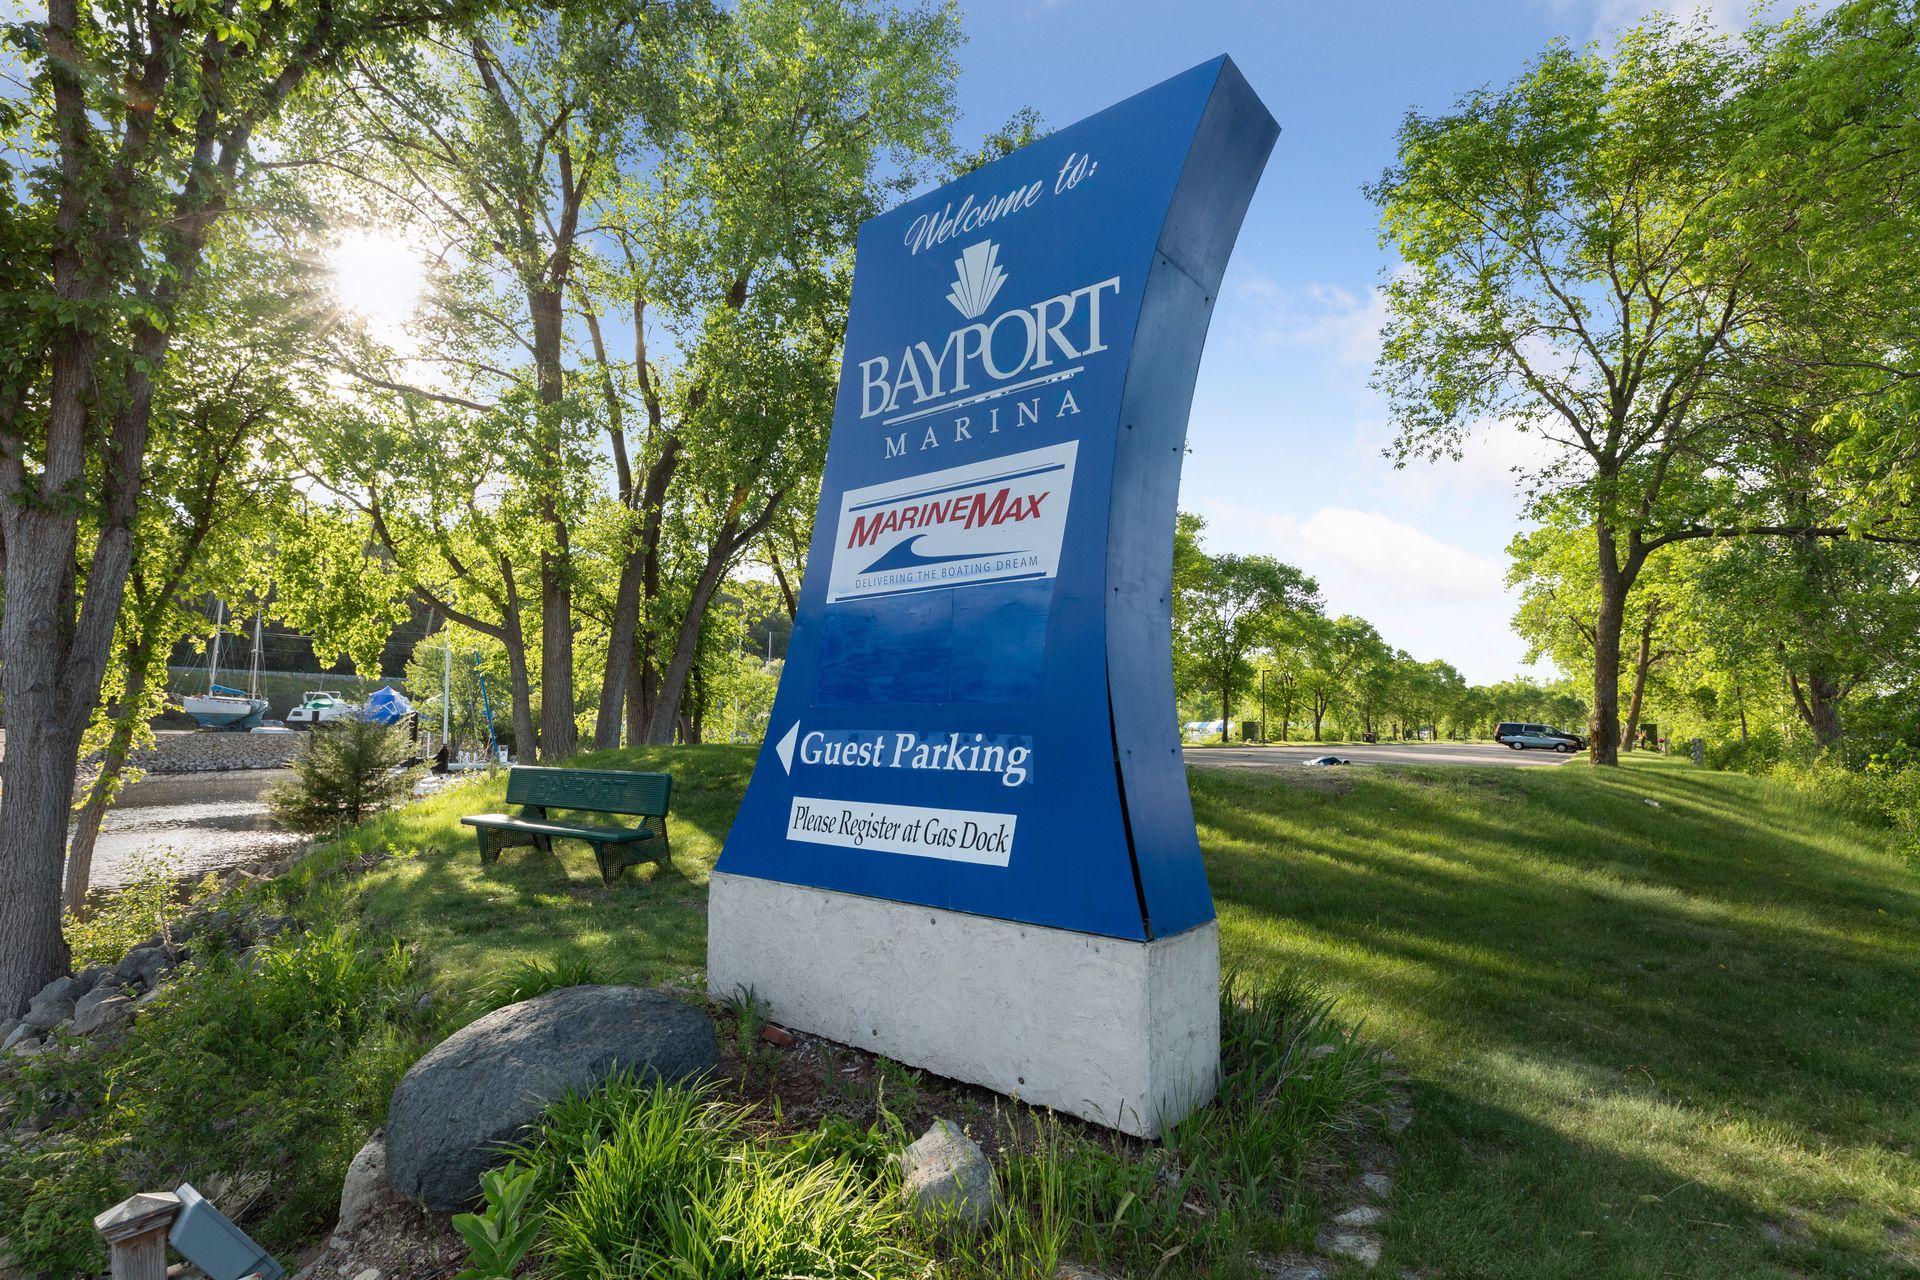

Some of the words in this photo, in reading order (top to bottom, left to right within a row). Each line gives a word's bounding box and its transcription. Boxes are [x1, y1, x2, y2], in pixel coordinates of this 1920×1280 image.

[904, 180, 1043, 255] Welcome
[1054, 152, 1098, 195] to:
[858, 276, 1120, 419] BAYPORT
[884, 390, 1081, 459] MARINA
[855, 572, 913, 588] DELIVERING
[917, 569, 936, 581] THE
[941, 562, 990, 578] BOATING
[996, 555, 1038, 571] DREAM
[800, 731, 884, 768] Guest
[890, 732, 1031, 787] Parking
[792, 805, 837, 834] Please
[838, 809, 901, 845] Register
[903, 818, 921, 844] at
[923, 818, 957, 848] Gas
[959, 821, 1009, 854] Dock
